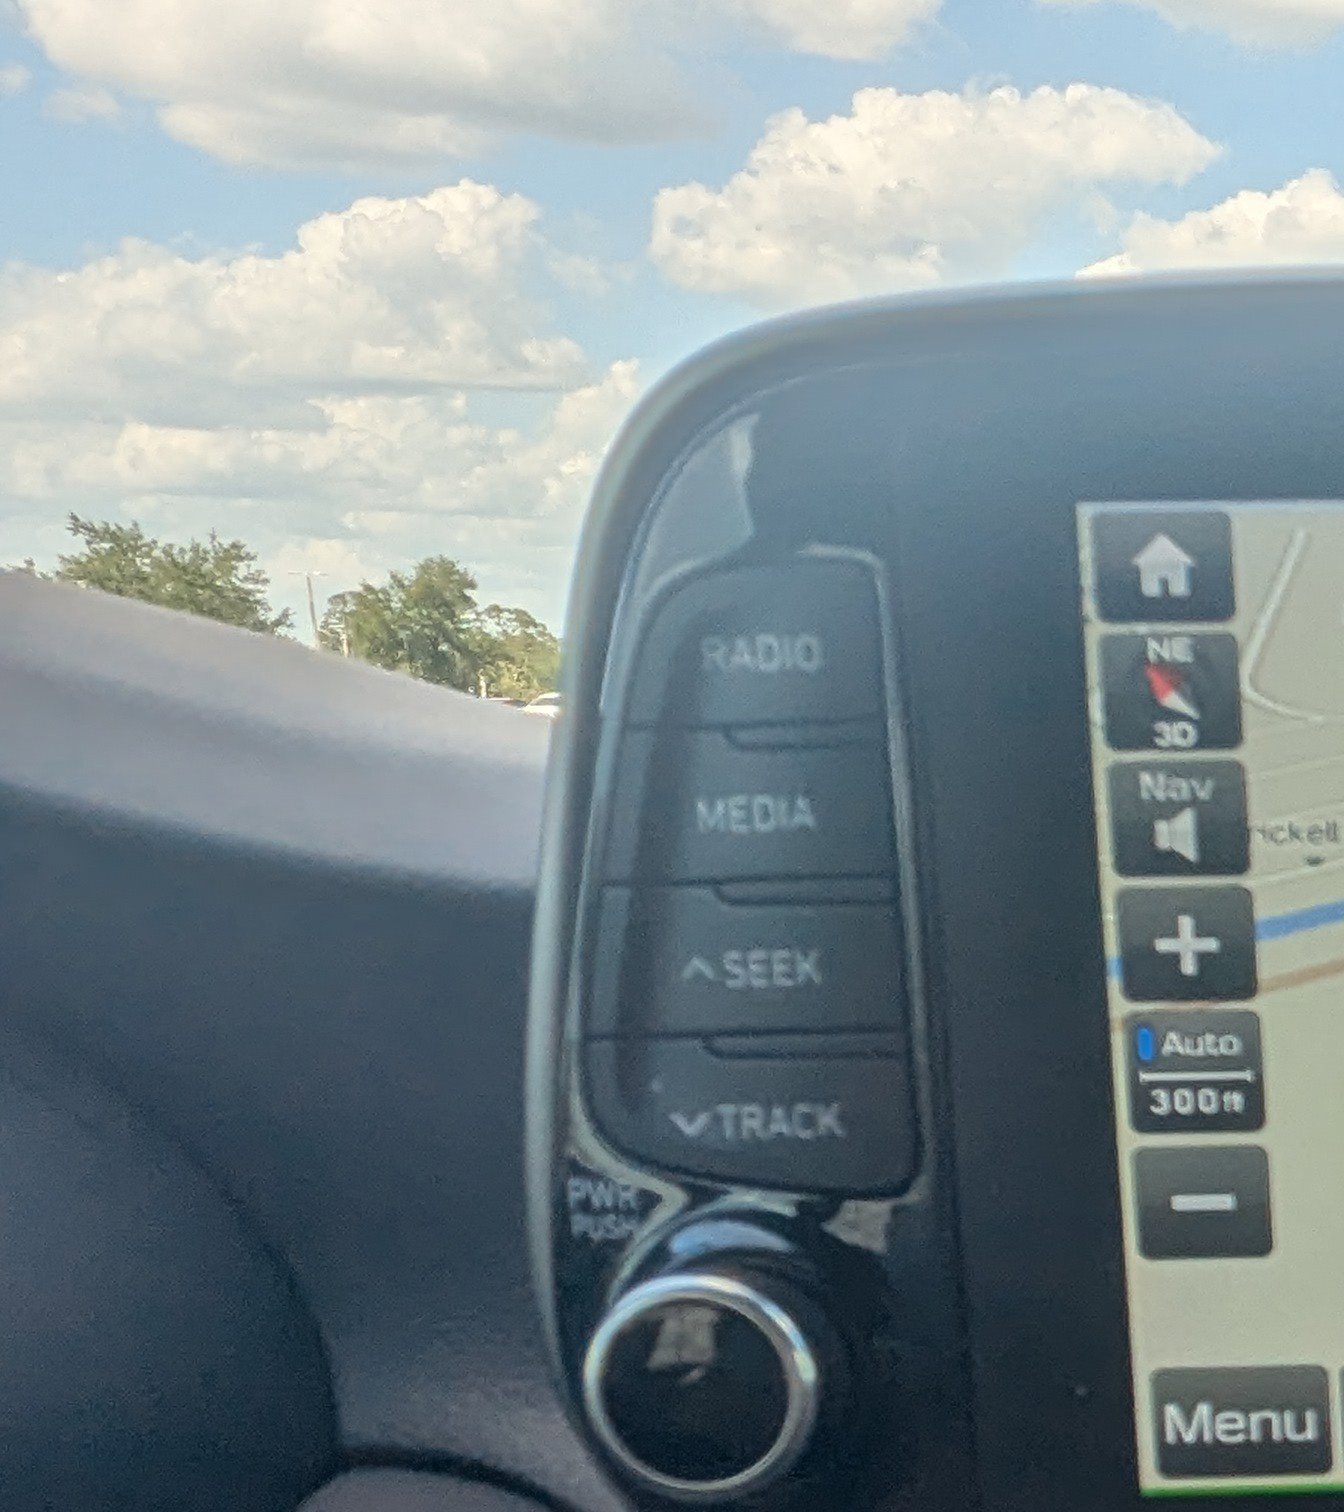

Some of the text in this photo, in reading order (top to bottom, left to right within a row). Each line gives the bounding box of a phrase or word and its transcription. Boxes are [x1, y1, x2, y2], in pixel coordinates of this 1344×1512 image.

[703, 634, 824, 673] RADIO
[1146, 636, 1195, 664] NE
[1152, 721, 1198, 748] 3D
[1138, 770, 1215, 801] Nav
[696, 794, 815, 835] MEDIA
[721, 949, 823, 988] SEEK
[1161, 1031, 1243, 1057] Auto
[719, 1103, 845, 1141] TRACK
[1162, 1402, 1321, 1446] Menu
